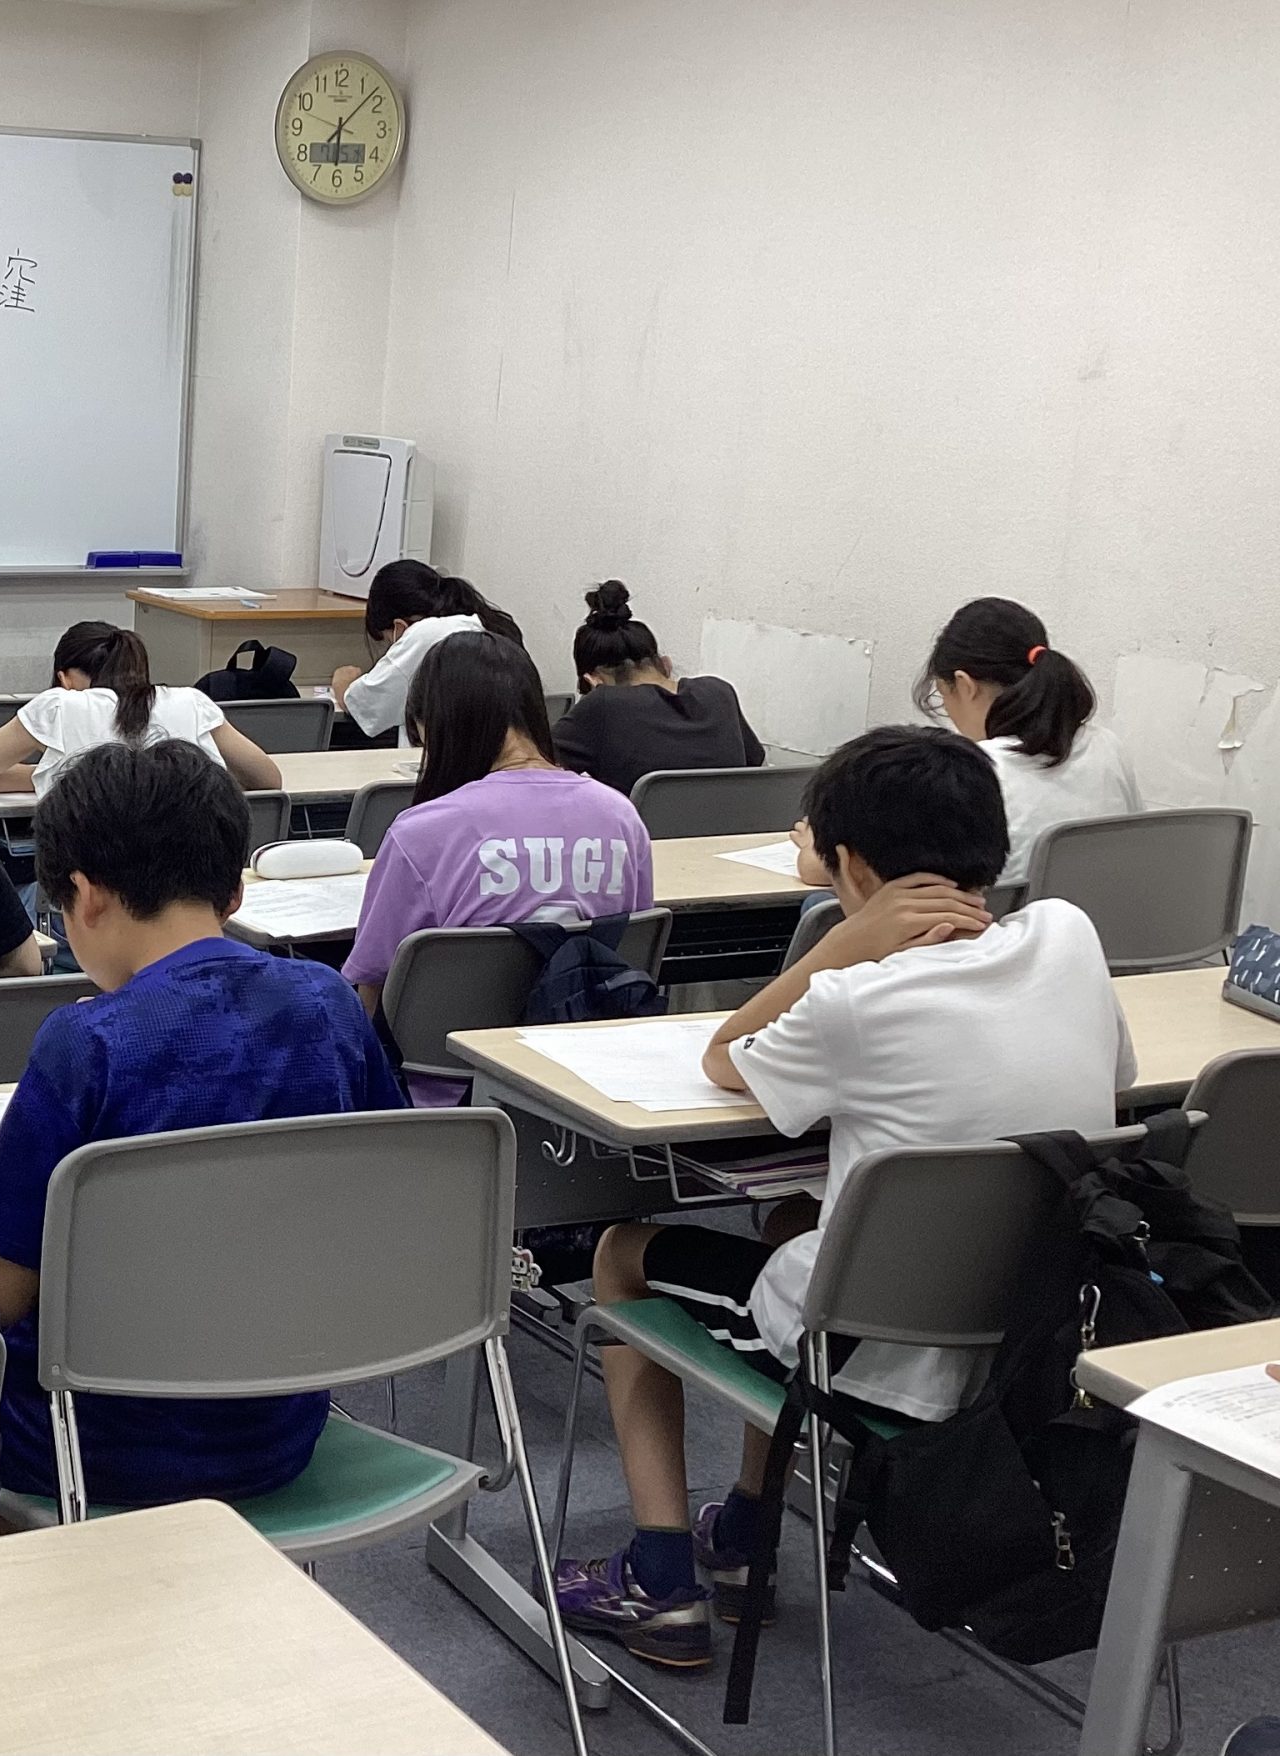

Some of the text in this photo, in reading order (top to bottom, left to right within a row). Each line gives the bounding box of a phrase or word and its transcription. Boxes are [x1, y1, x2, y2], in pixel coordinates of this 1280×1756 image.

[315, 74, 327, 93] 11
[334, 68, 350, 88] 12
[360, 76, 365, 95] 1
[298, 92, 313, 111] 10
[371, 95, 383, 114] 2
[291, 117, 303, 136] 9
[376, 120, 387, 139] 3
[296, 143, 308, 162] 8
[369, 146, 380, 163] 4
[312, 164, 322, 182] 7
[331, 169, 342, 188] 6
[353, 164, 364, 182] 5
